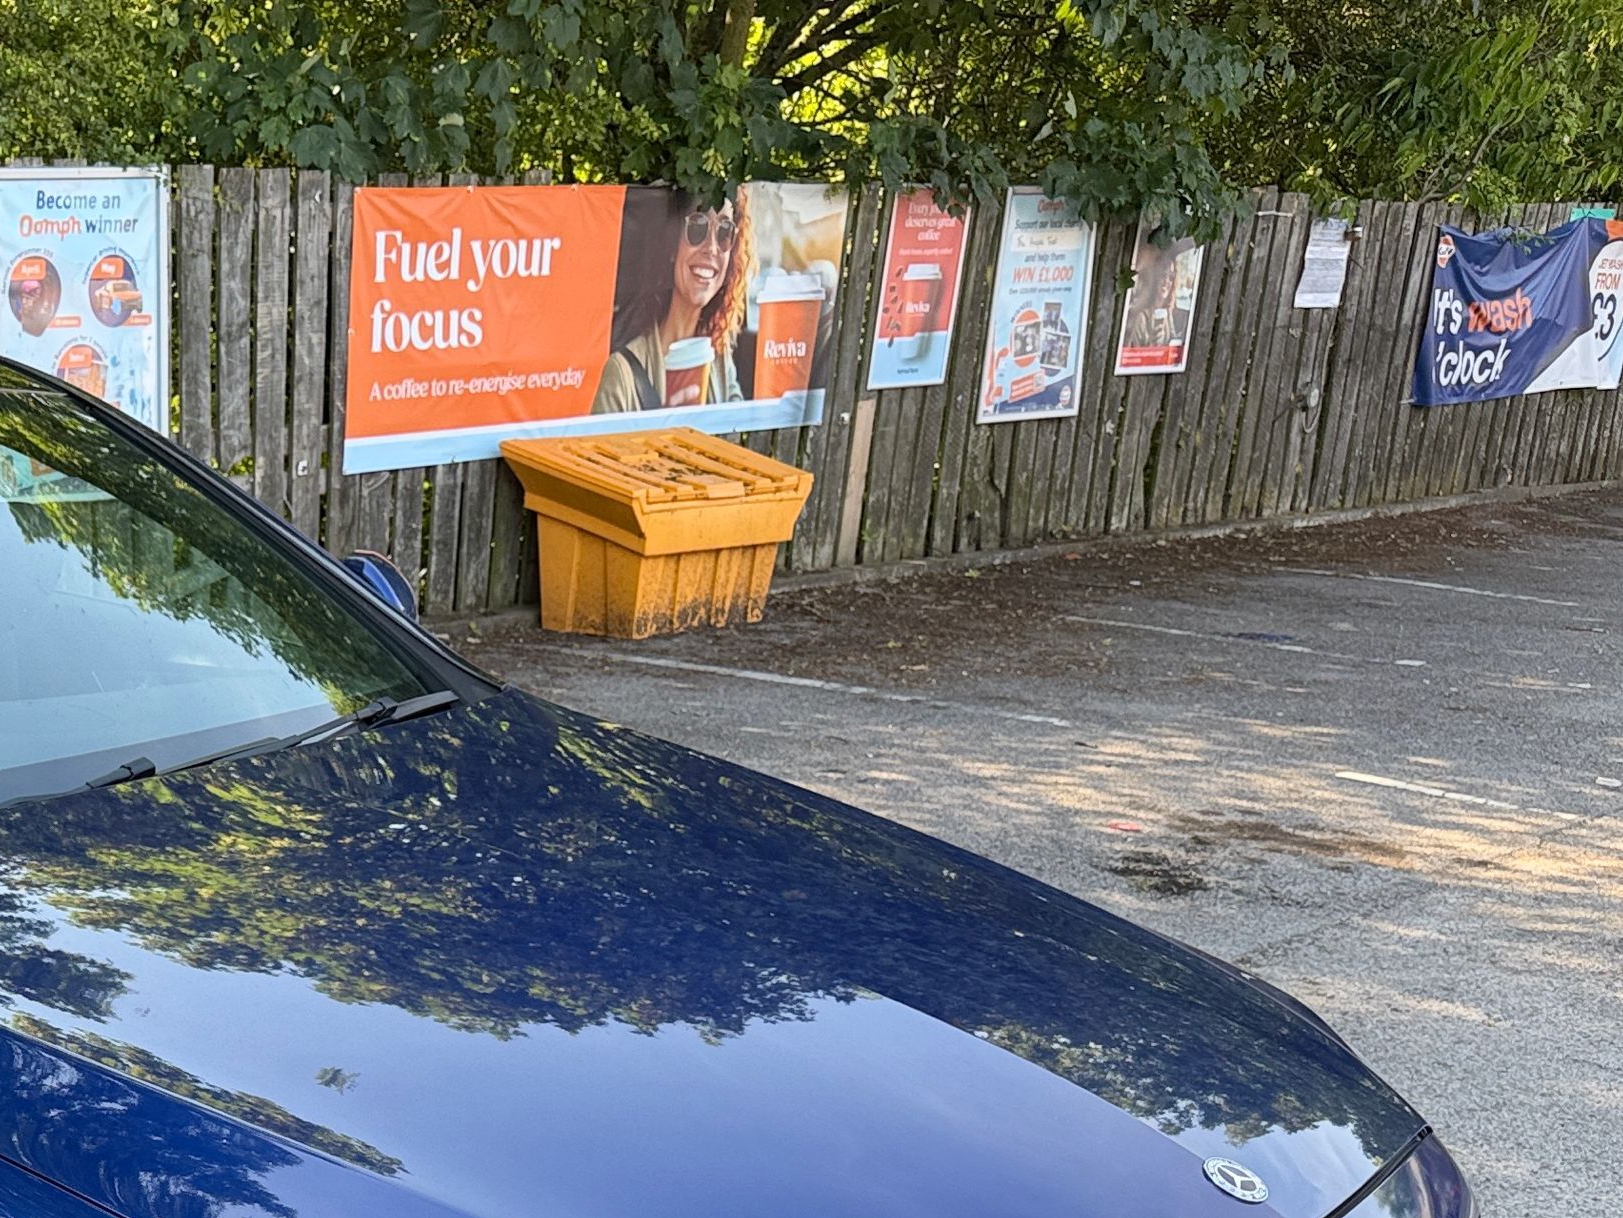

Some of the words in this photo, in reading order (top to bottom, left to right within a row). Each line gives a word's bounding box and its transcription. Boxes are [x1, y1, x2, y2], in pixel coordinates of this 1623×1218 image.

[36, 190, 97, 210] Become
[102, 194, 121, 209] an
[20, 214, 82, 241] Oomph
[85, 214, 139, 233] winner
[374, 227, 462, 283] Fuel
[466, 237, 562, 292] your
[1595, 272, 1622, 290] FROM
[370, 298, 484, 353] focus
[1433, 288, 1463, 335] It's
[1467, 287, 1533, 333] wash
[1431, 338, 1512, 387] 'clock
[369, 382, 382, 401] A
[383, 377, 428, 400] coffee
[430, 378, 447, 397] to
[449, 370, 526, 395] re-energise
[527, 366, 586, 391] everyday
